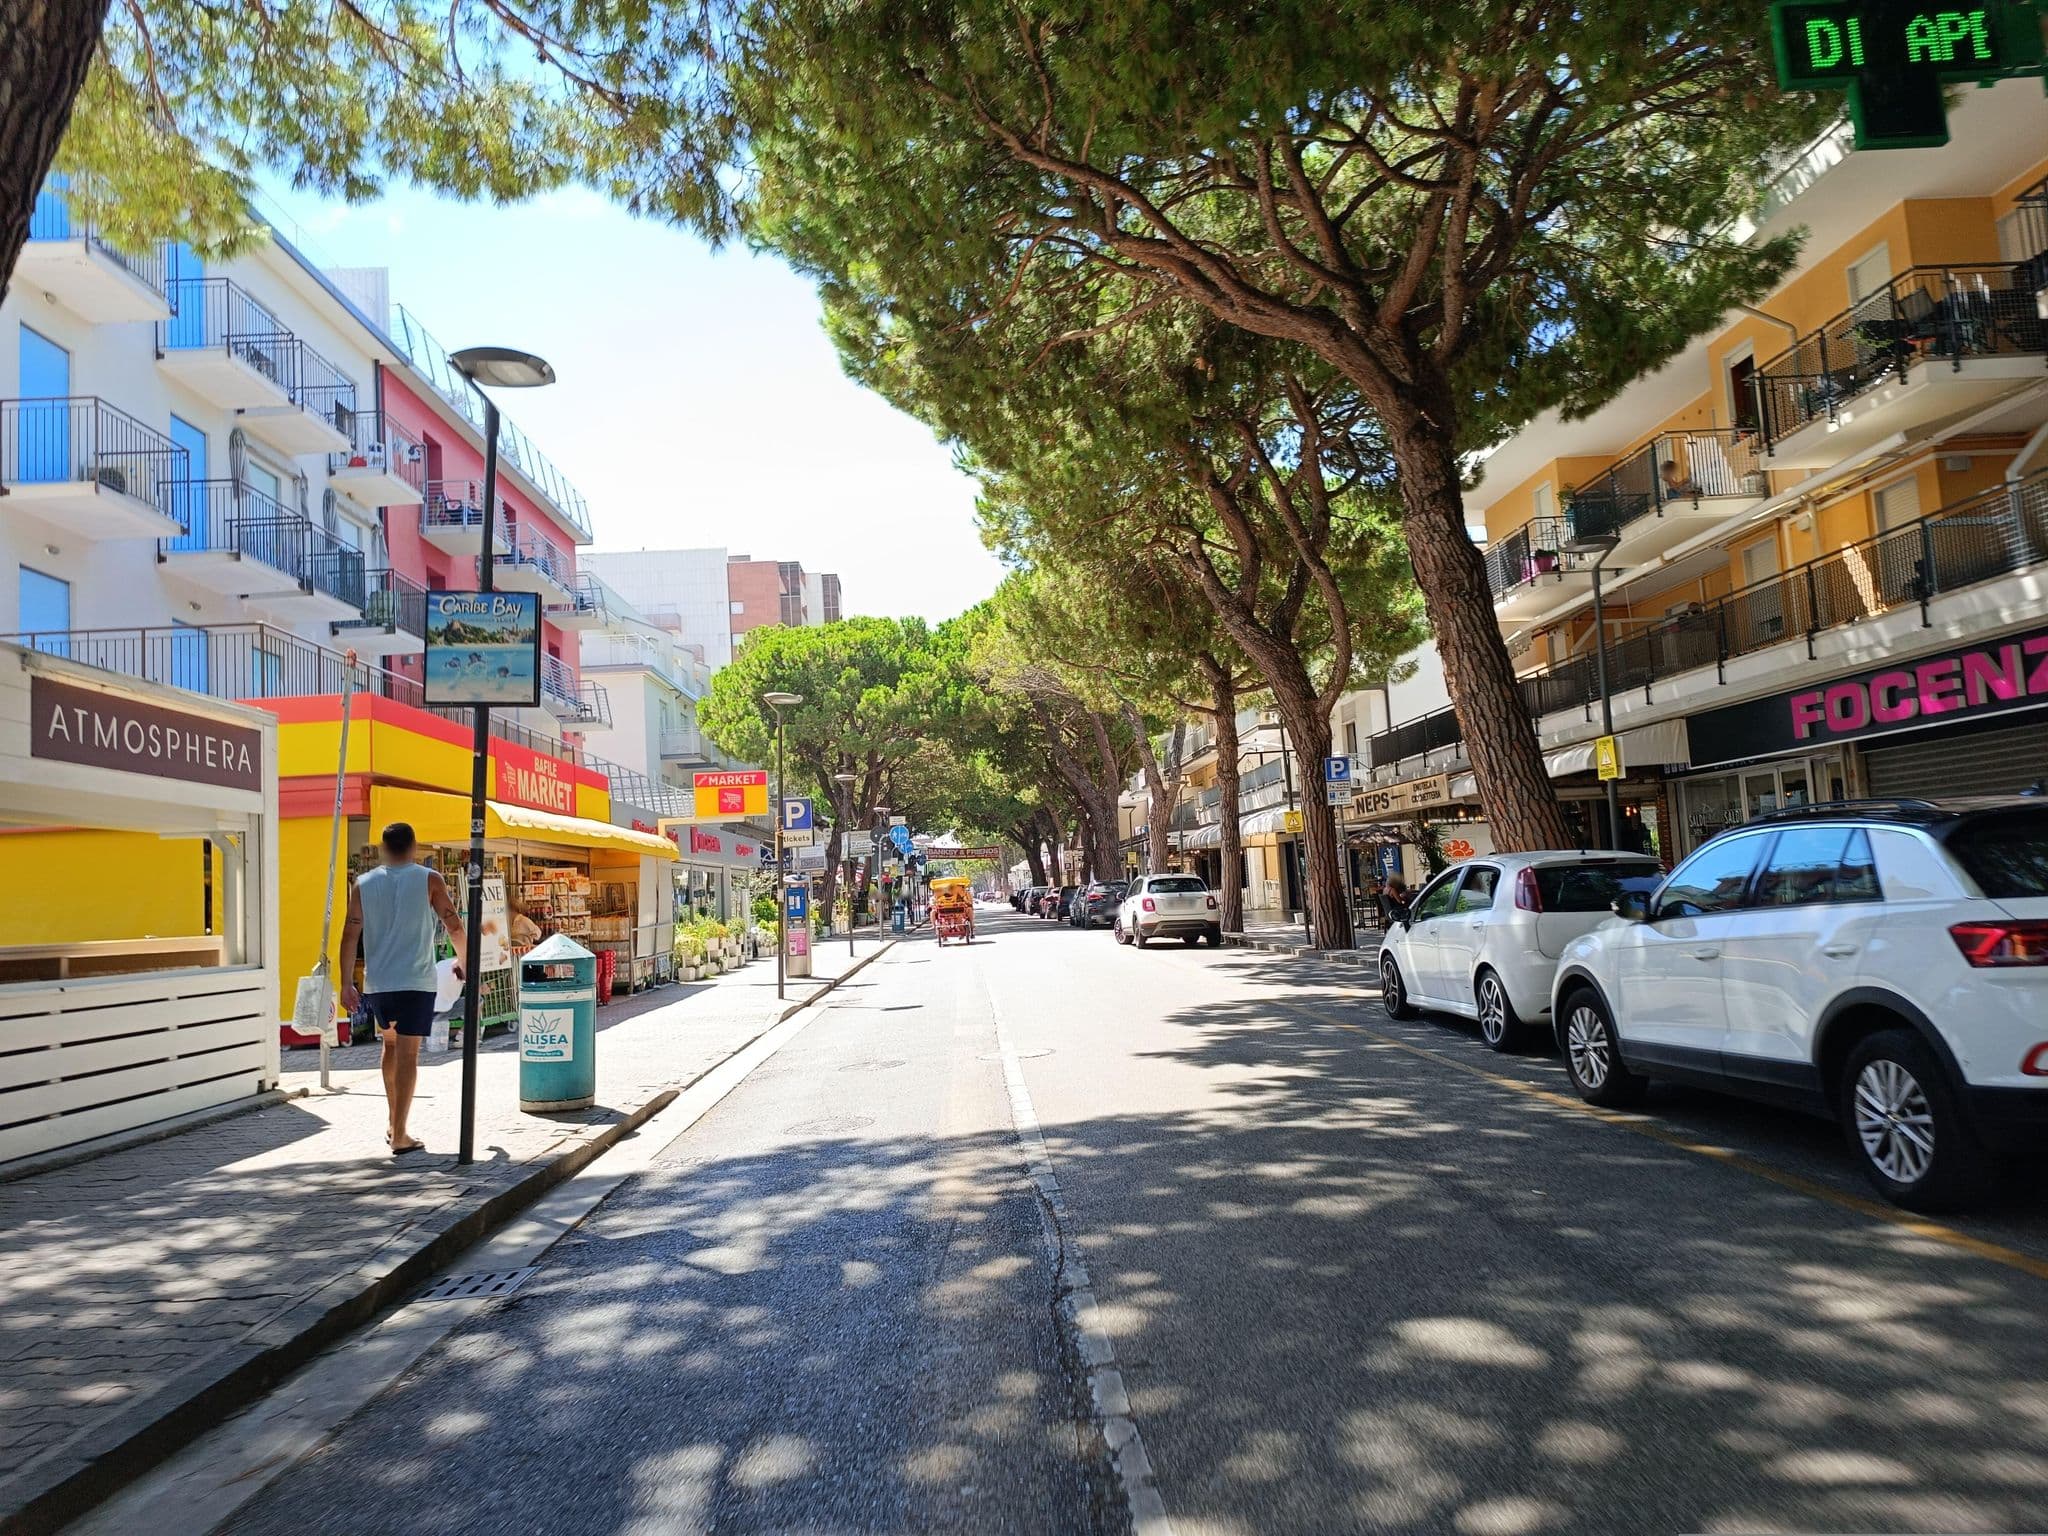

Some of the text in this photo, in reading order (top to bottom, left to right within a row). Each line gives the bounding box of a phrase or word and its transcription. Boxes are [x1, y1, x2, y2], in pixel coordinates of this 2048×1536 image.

[1805, 16, 1865, 69] DI
[48, 703, 253, 775] ATMOSPHERA
[534, 756, 558, 778] BAFILE
[1330, 760, 1345, 778] P
[517, 767, 573, 812] MARKET
[708, 774, 758, 786] MARKET
[785, 801, 806, 828] P
[1356, 792, 1390, 815] NEPS
[783, 835, 810, 843] tickets
[523, 1034, 568, 1045] ALISEA
